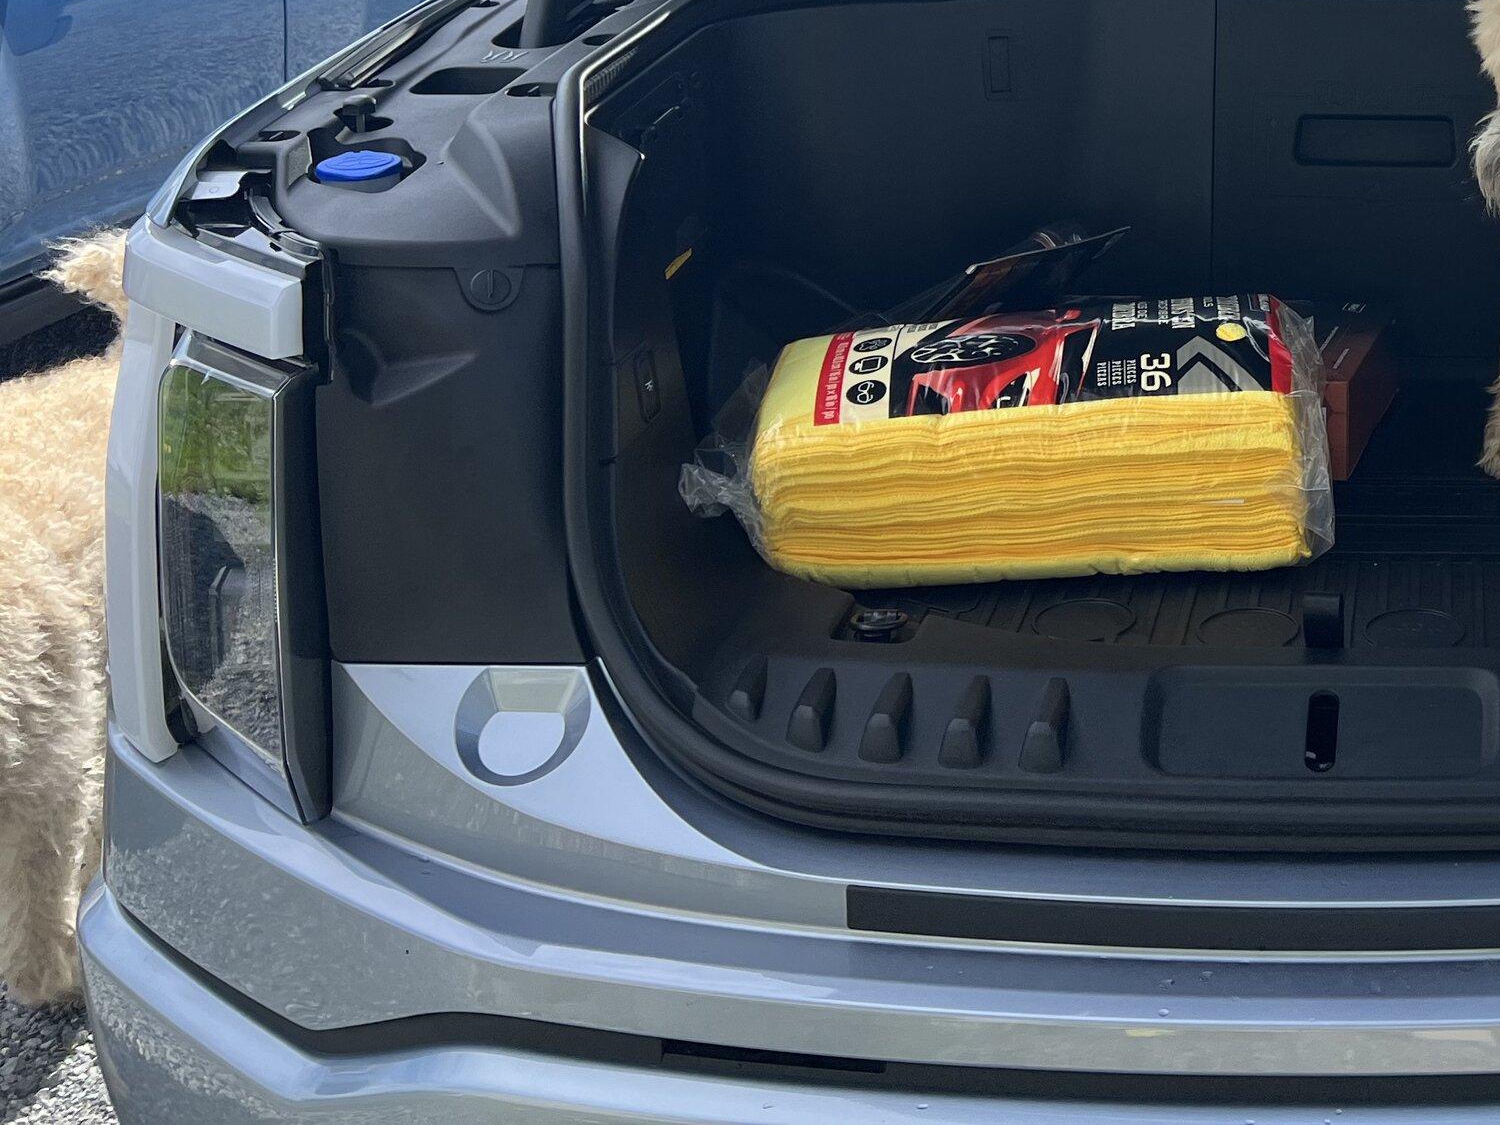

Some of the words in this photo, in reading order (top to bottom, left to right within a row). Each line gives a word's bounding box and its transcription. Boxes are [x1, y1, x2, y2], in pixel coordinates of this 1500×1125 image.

[1097, 362, 1107, 387] PIEZAS
[1112, 360, 1123, 385] PIÈCES
[1127, 359, 1137, 384] PIECES
[1140, 353, 1172, 391] 36
